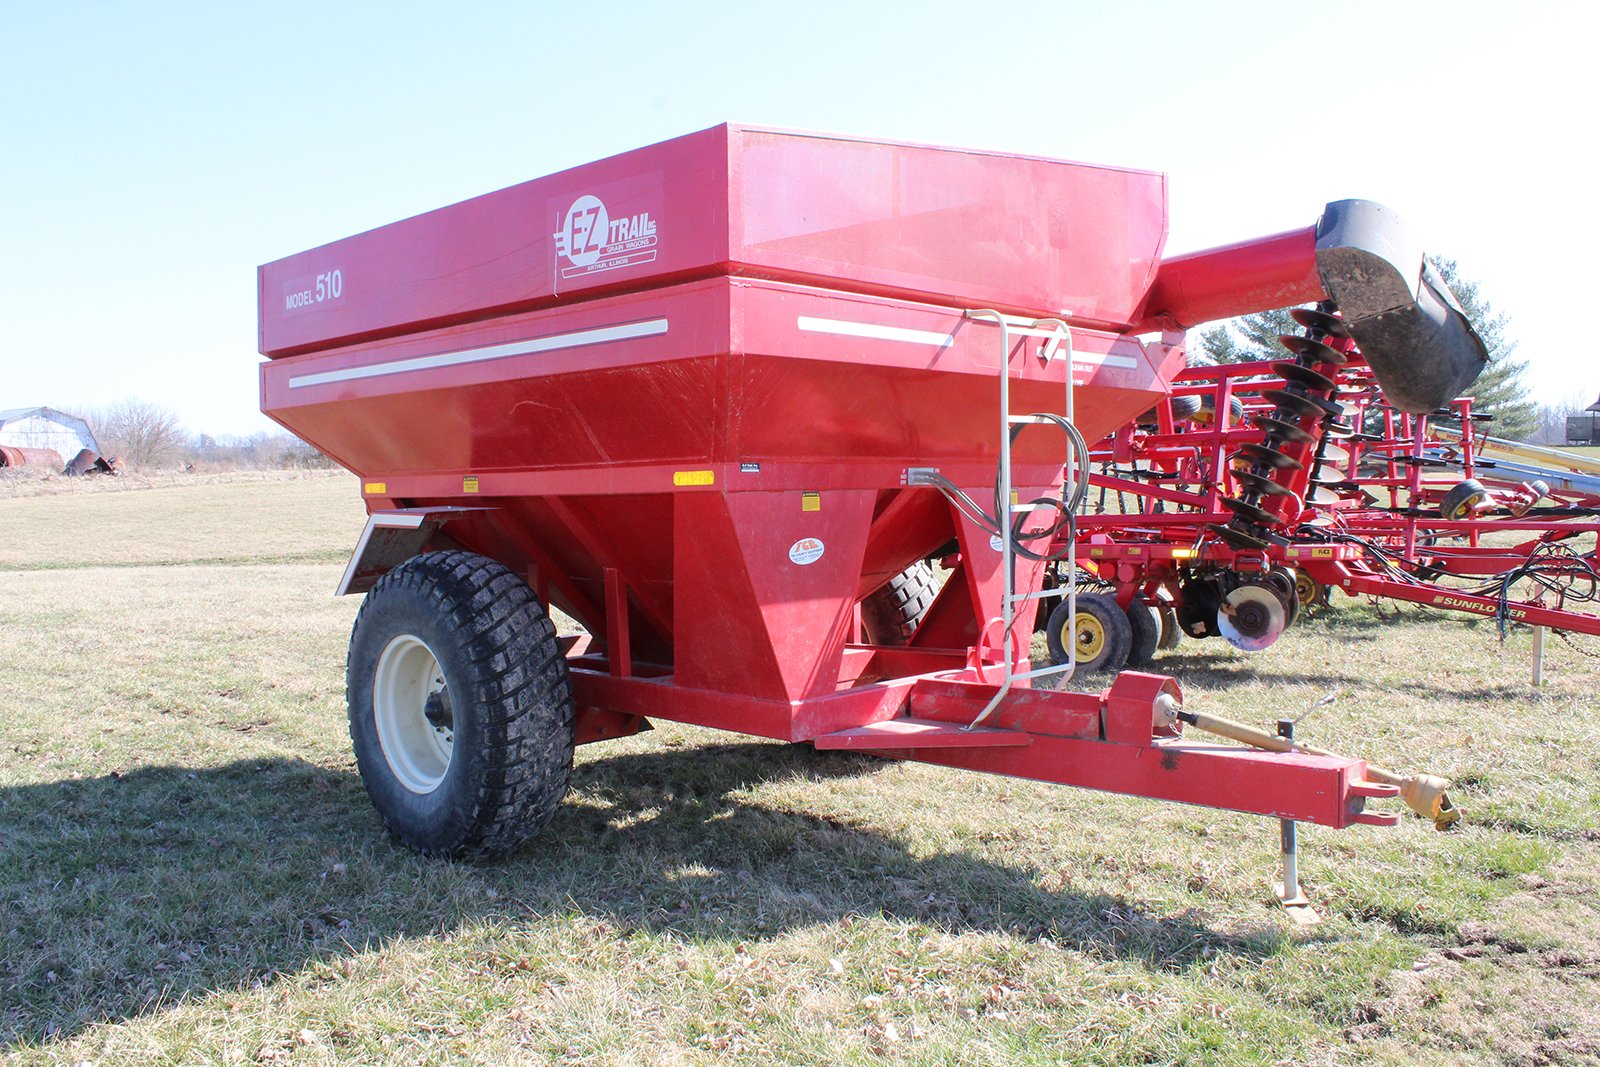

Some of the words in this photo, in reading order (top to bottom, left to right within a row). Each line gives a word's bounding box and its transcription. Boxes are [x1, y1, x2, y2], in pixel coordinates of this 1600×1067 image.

[609, 212, 656, 243] TRAIL
[606, 243, 624, 253] GRAIN
[626, 238, 650, 249] WAGONS
[609, 257, 629, 267] ILLINOIS
[286, 290, 314, 310] MODEL
[316, 269, 342, 302] 510
[1443, 597, 1526, 619] SUNFLOER
